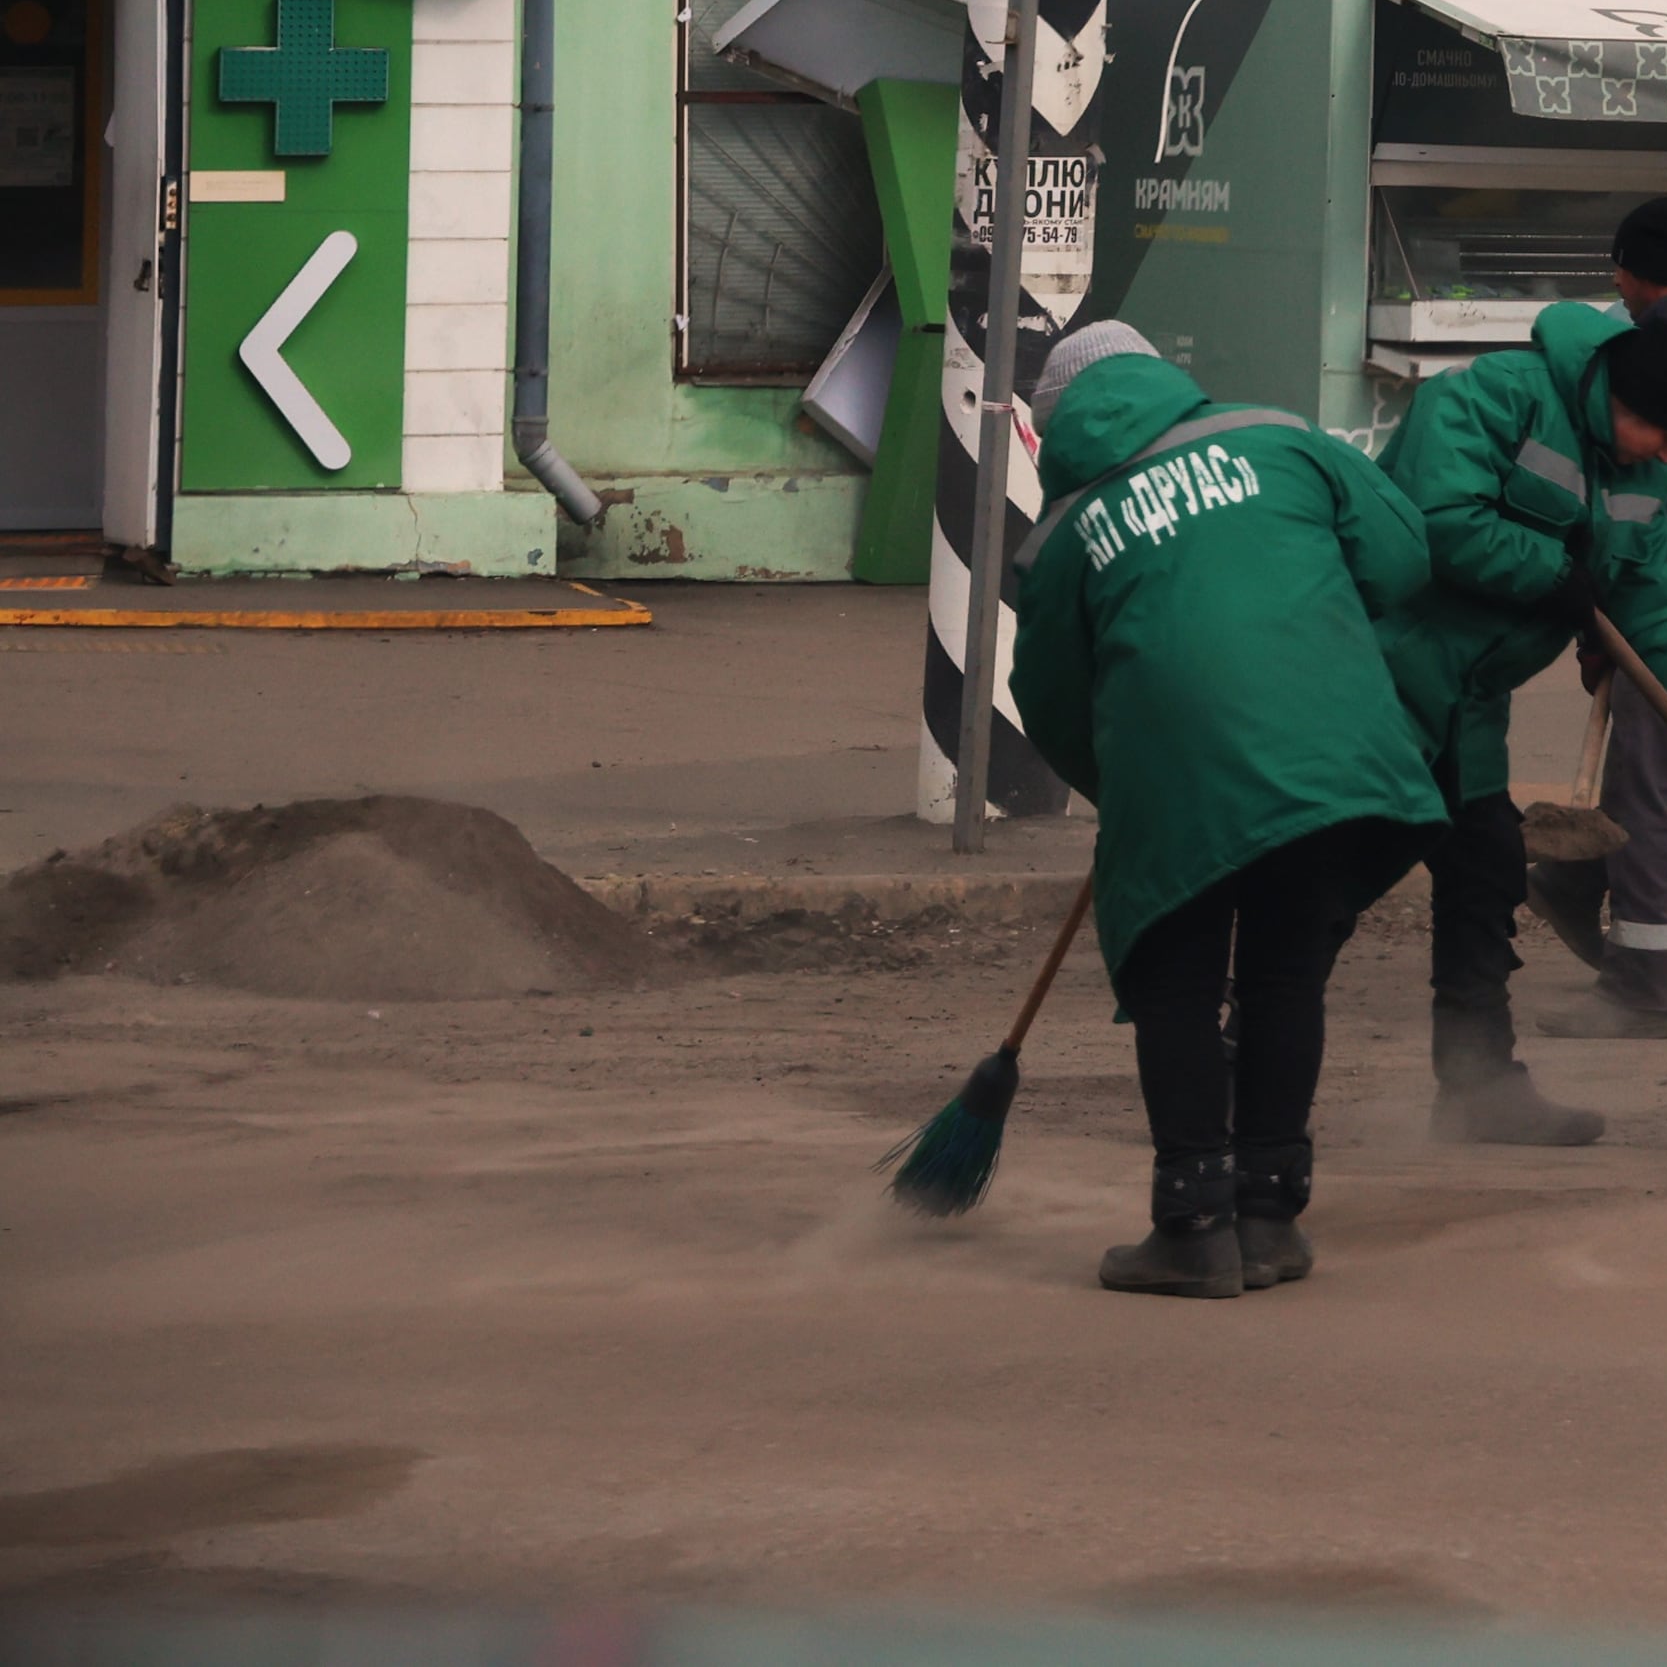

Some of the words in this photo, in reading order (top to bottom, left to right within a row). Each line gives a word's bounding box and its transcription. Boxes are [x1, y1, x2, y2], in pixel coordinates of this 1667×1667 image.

[1417, 49, 1472, 66] СМАЧНО
[975, 158, 1085, 187] КЛЮ
[974, 189, 1083, 224] ДОНИ
[1135, 178, 1231, 212] КРАМНЯМ
[1074, 498, 1126, 571] КП
[1121, 444, 1260, 545] «ДРУАС»
